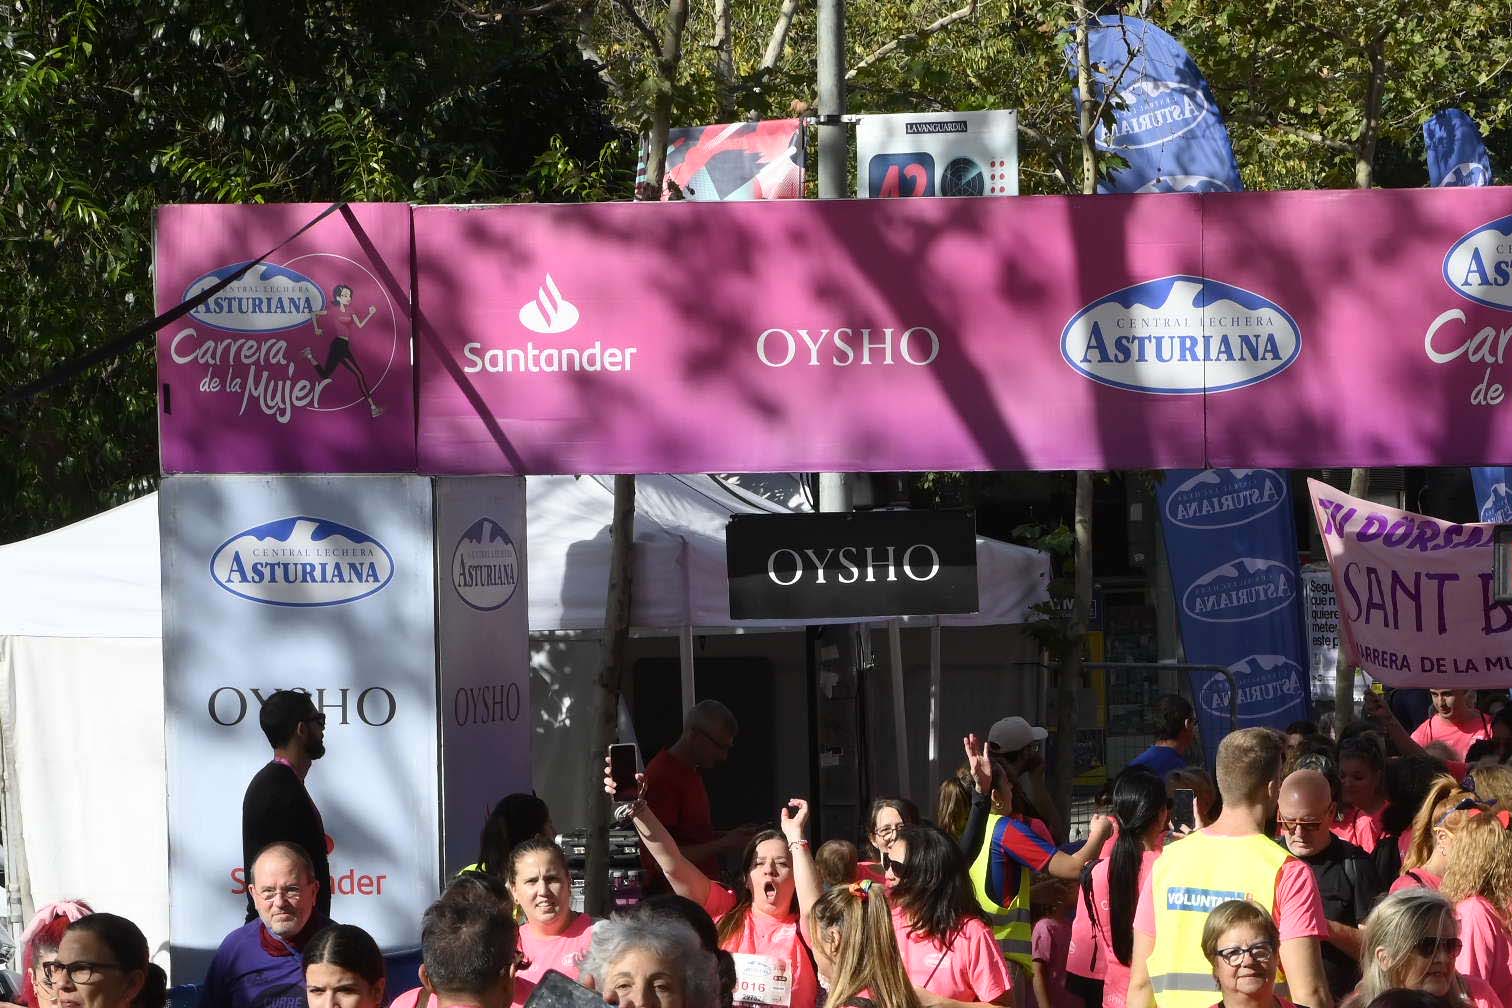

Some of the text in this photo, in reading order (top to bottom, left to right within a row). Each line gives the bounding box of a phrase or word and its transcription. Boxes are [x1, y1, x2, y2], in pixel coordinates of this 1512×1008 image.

[916, 122, 967, 132] VANGUARDIA
[194, 287, 315, 315] ASTURIANA
[221, 285, 310, 293] ENTRAL LECHERA
[1116, 315, 1275, 329] CENTRAL LECHERA
[170, 327, 288, 364] Carrera
[463, 340, 638, 373] Santander
[756, 326, 940, 368] OYSHO
[1080, 321, 1283, 364] ASTURIANA
[200, 360, 333, 424] de la Mujer
[1470, 371, 1504, 406] de
[225, 551, 381, 585] ASTURIANA
[253, 549, 375, 558] CENTRAL LECHERA
[767, 544, 940, 586] OYSHO
[457, 554, 516, 588] ASTURIANA
[1310, 579, 1335, 593] Segu
[1311, 608, 1339, 622] quiere
[1343, 561, 1460, 636] SANT
[1421, 656, 1448, 674] DE
[1453, 659, 1483, 673] LA
[455, 681, 521, 728] OYSHO
